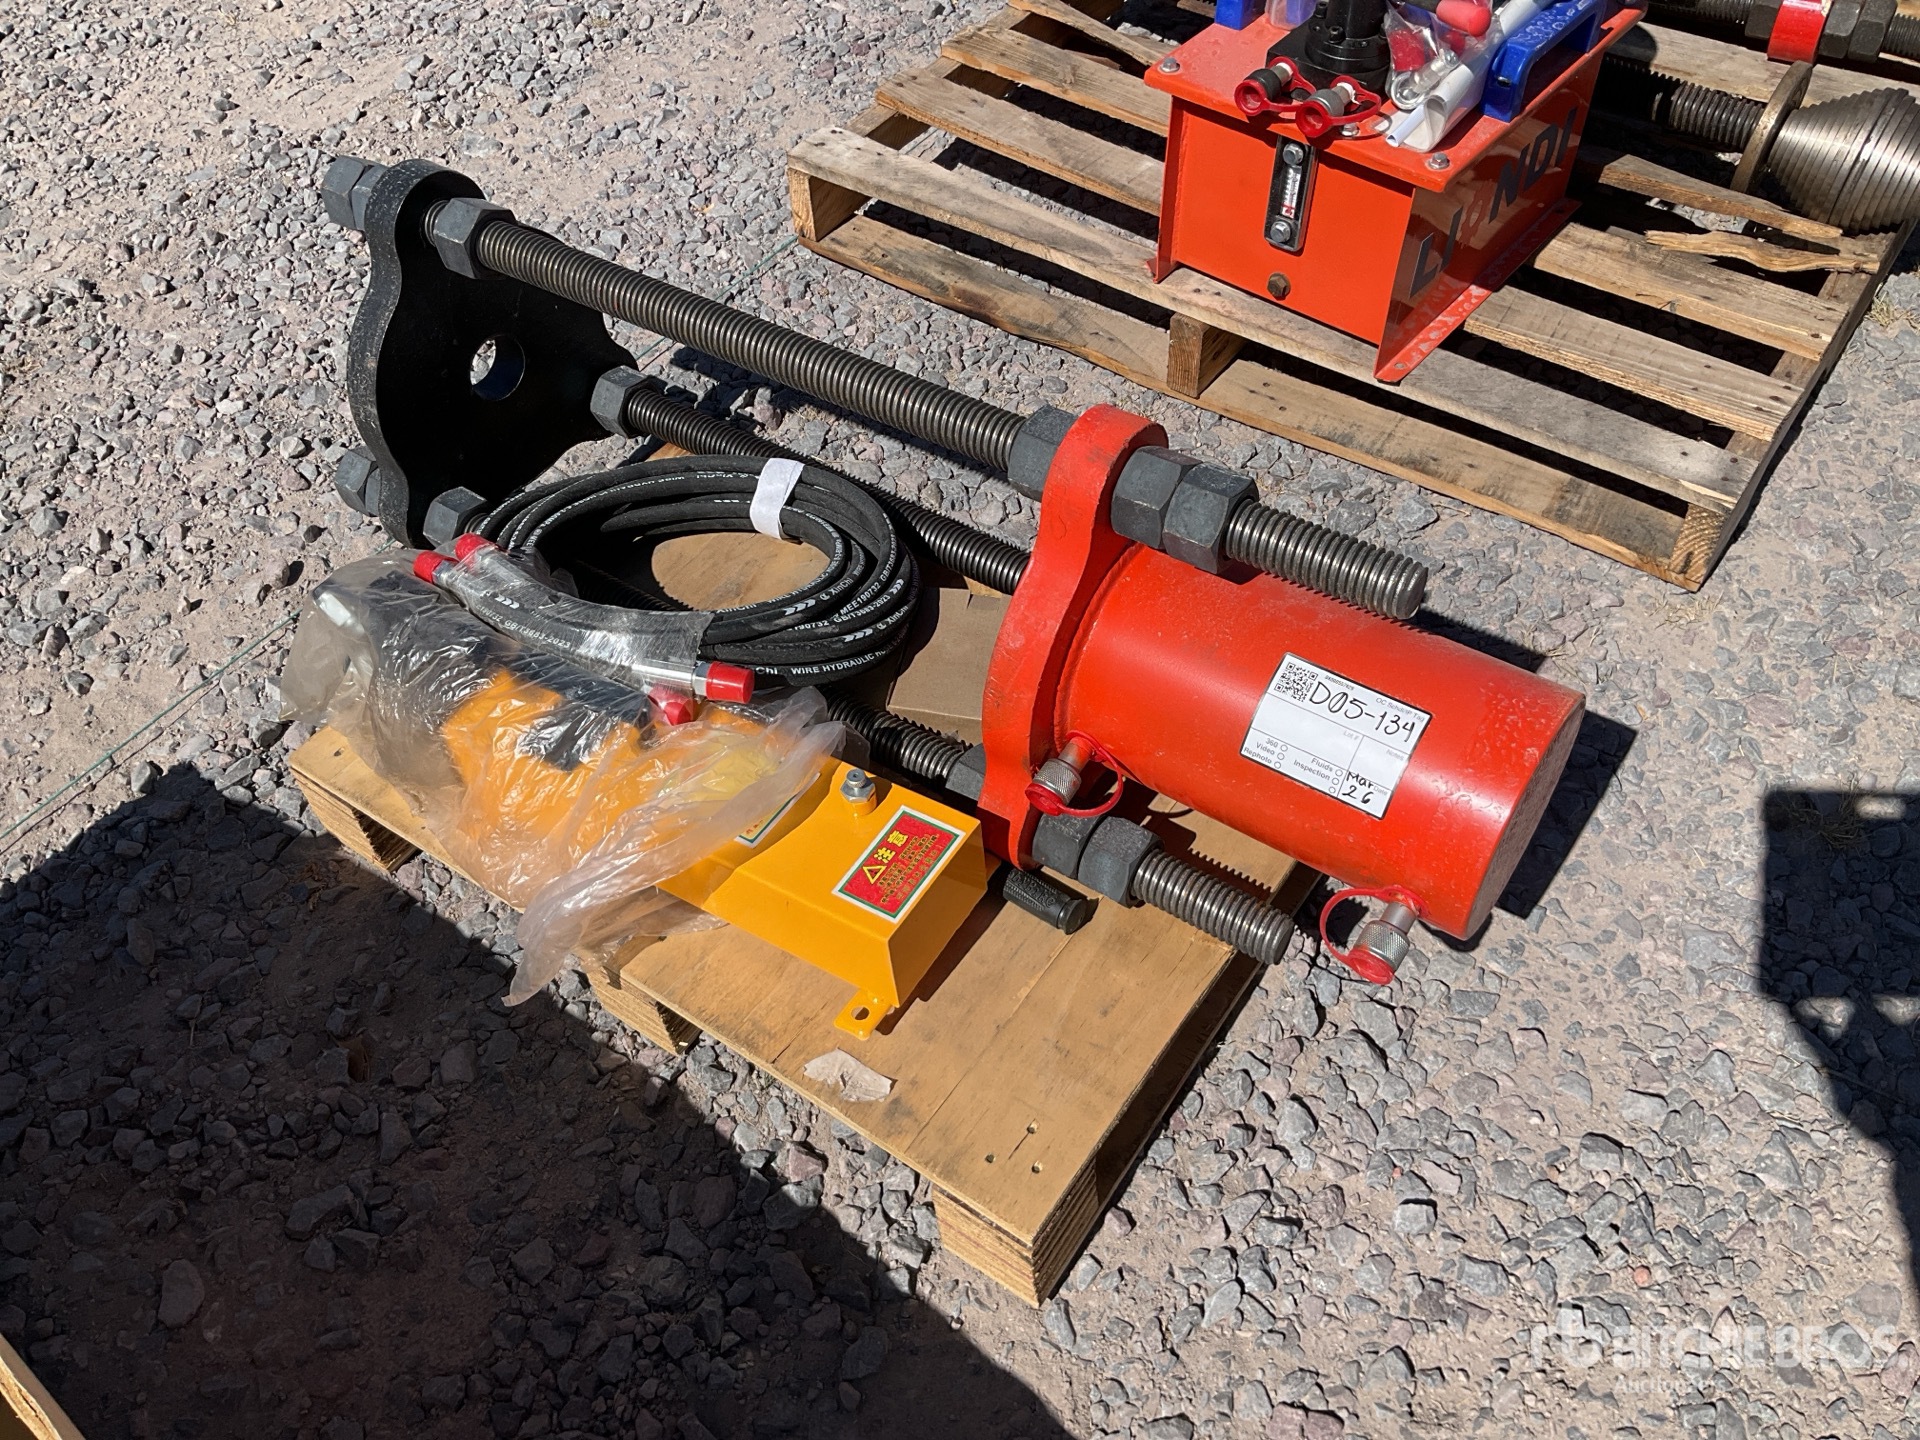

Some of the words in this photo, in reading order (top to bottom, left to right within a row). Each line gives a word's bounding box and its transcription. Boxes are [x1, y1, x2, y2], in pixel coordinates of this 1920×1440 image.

[829, 577, 854, 595] XinChi
[840, 581, 881, 615] MEE190732
[790, 666, 820, 675] WIRE
[822, 653, 875, 672] HYDRAULIC
[1256, 741, 1275, 755] Video
[1265, 737, 1279, 749] 360
[1243, 747, 1273, 765] Rephoto
[1386, 749, 1405, 761] Notes
[1293, 760, 1331, 781] Inspection
[1311, 757, 1333, 772] Fluids
[1346, 771, 1374, 789] Mar
[1341, 785, 1374, 804] 26
[1373, 786, 1388, 796] Date
